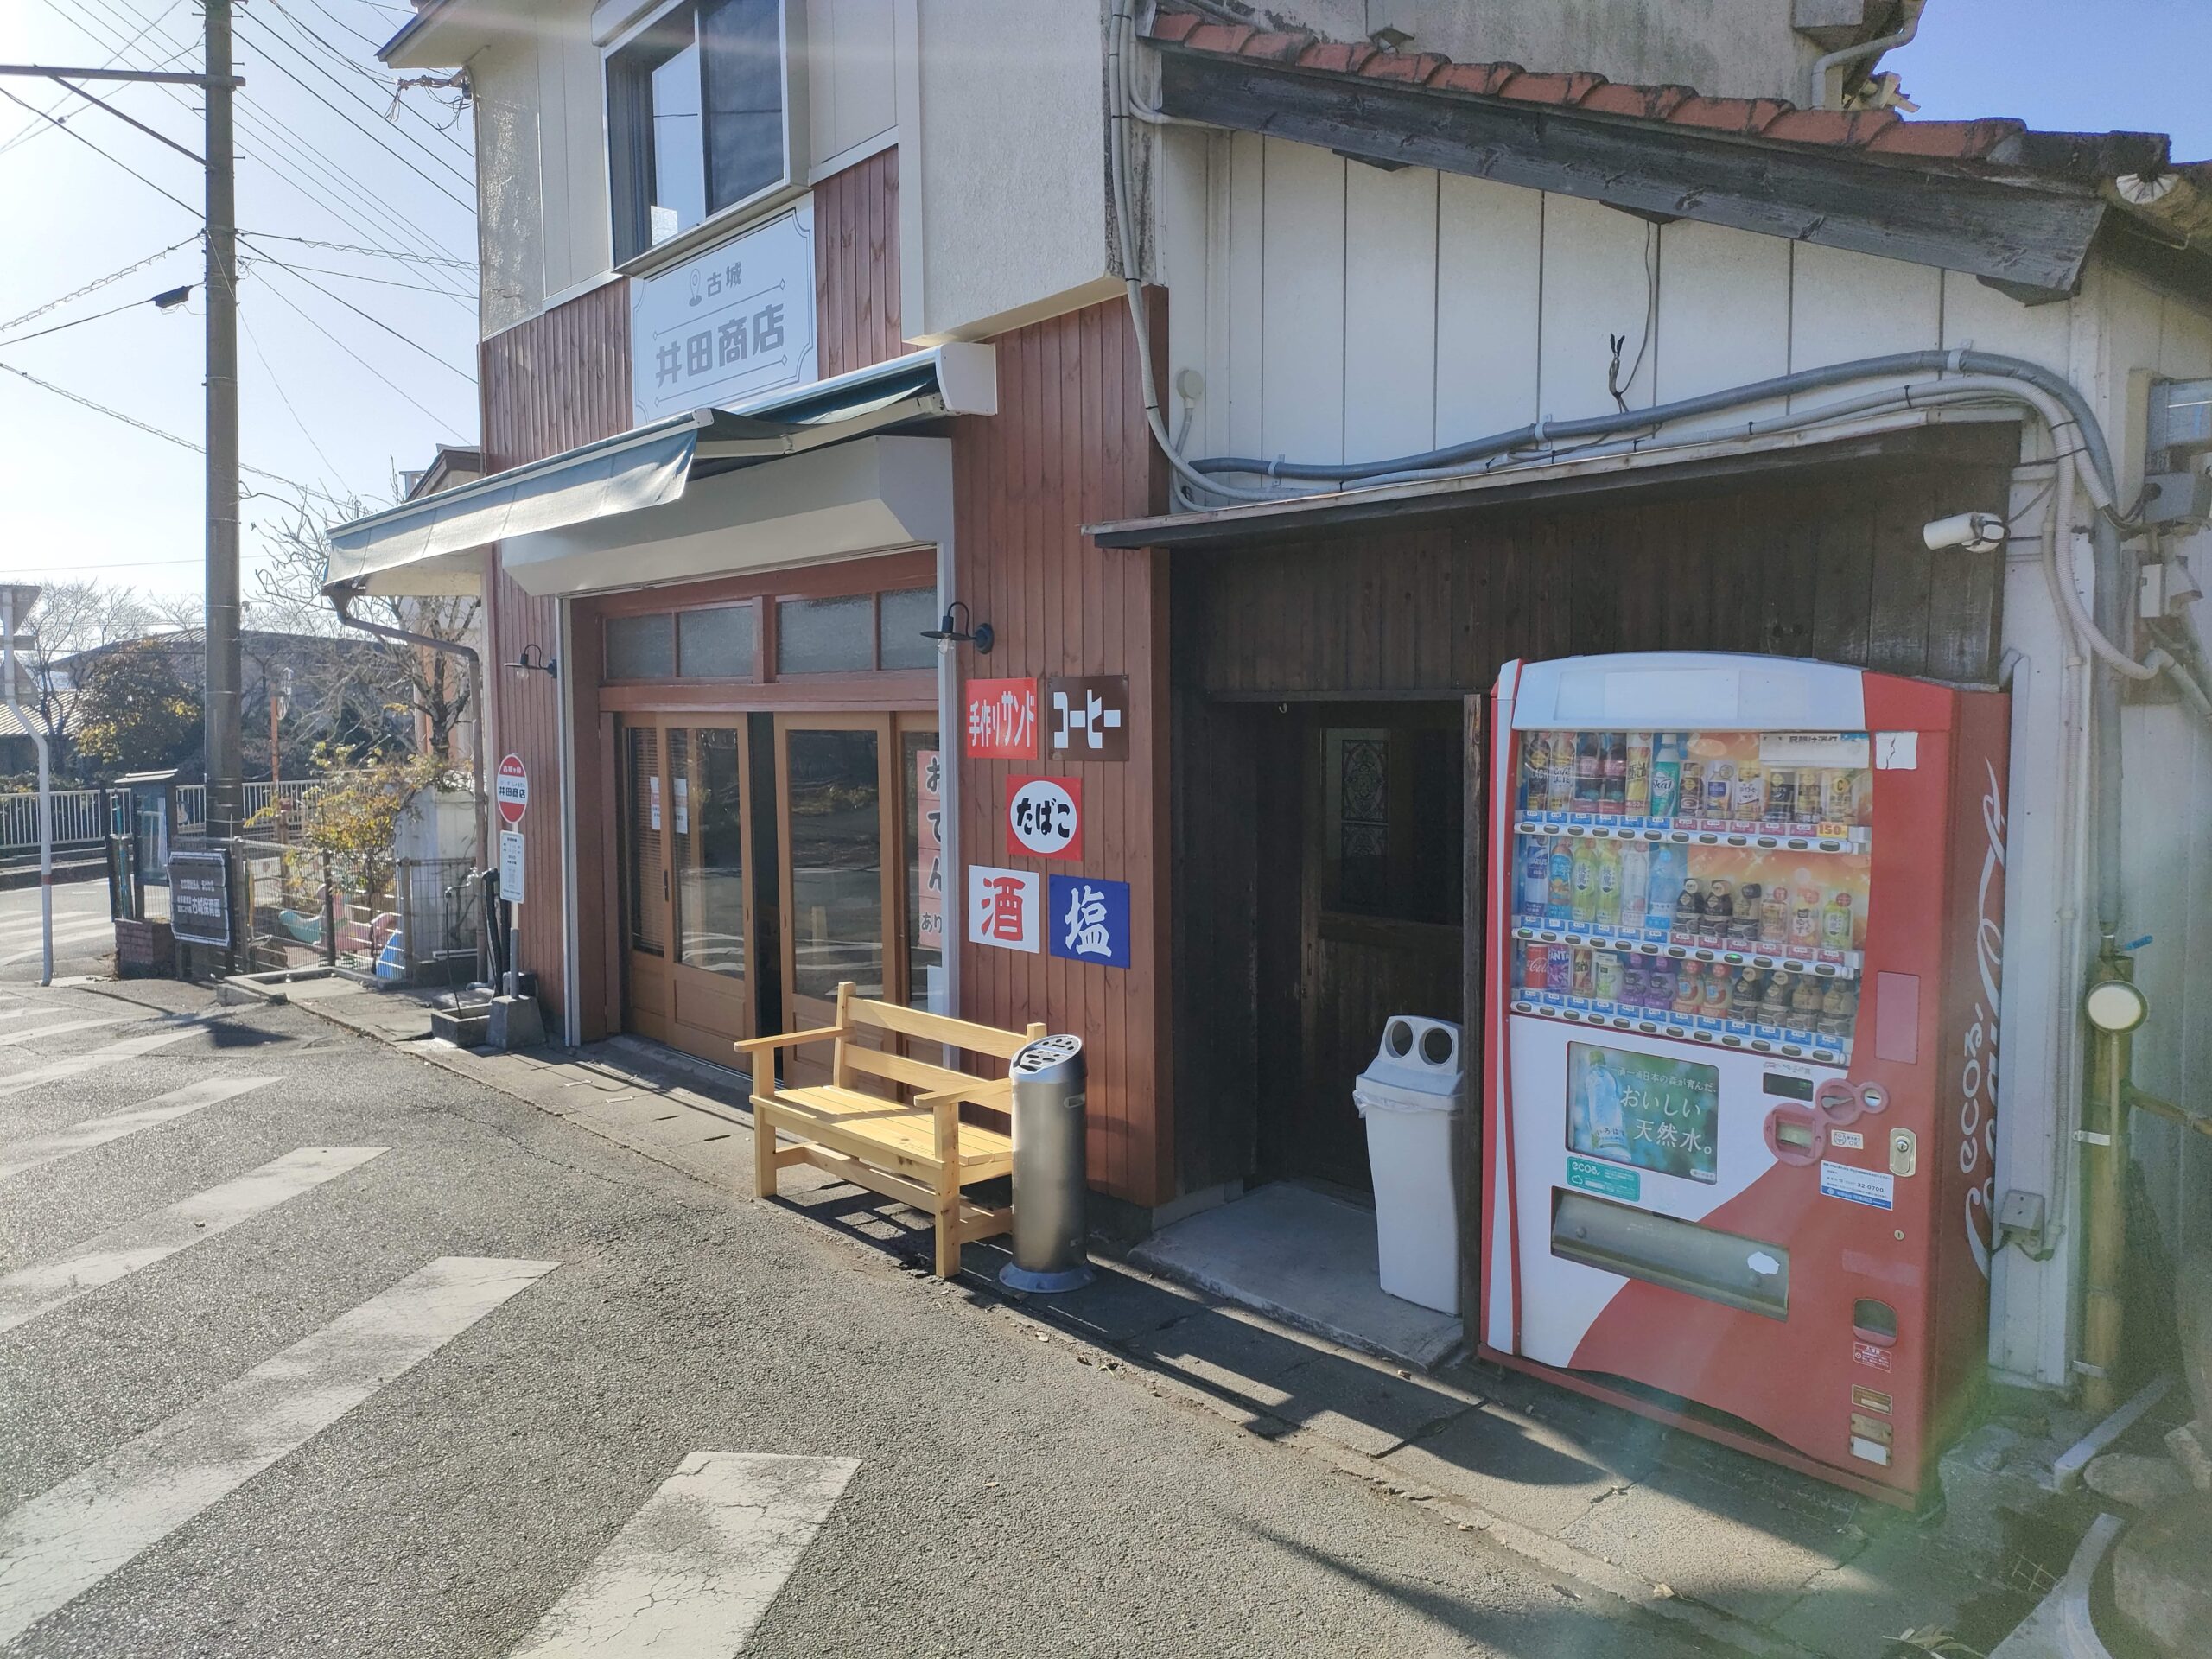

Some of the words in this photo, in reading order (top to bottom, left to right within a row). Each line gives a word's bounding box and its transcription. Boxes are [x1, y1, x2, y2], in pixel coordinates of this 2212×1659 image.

[707, 262, 741, 297] 古城
[655, 303, 785, 389] 井田商店
[969, 690, 1035, 747] 手作りサンド
[1053, 689, 1121, 749] コーヒー
[499, 786, 525, 799] 井田商店
[1017, 798, 1070, 838] たばこ
[982, 876, 1026, 942] 酒
[1065, 885, 1112, 957] 塩
[1620, 1084, 1700, 1118] おいしい
[1633, 1119, 1713, 1155] 天然水。
[1857, 1182, 1884, 1193] 32-0700
